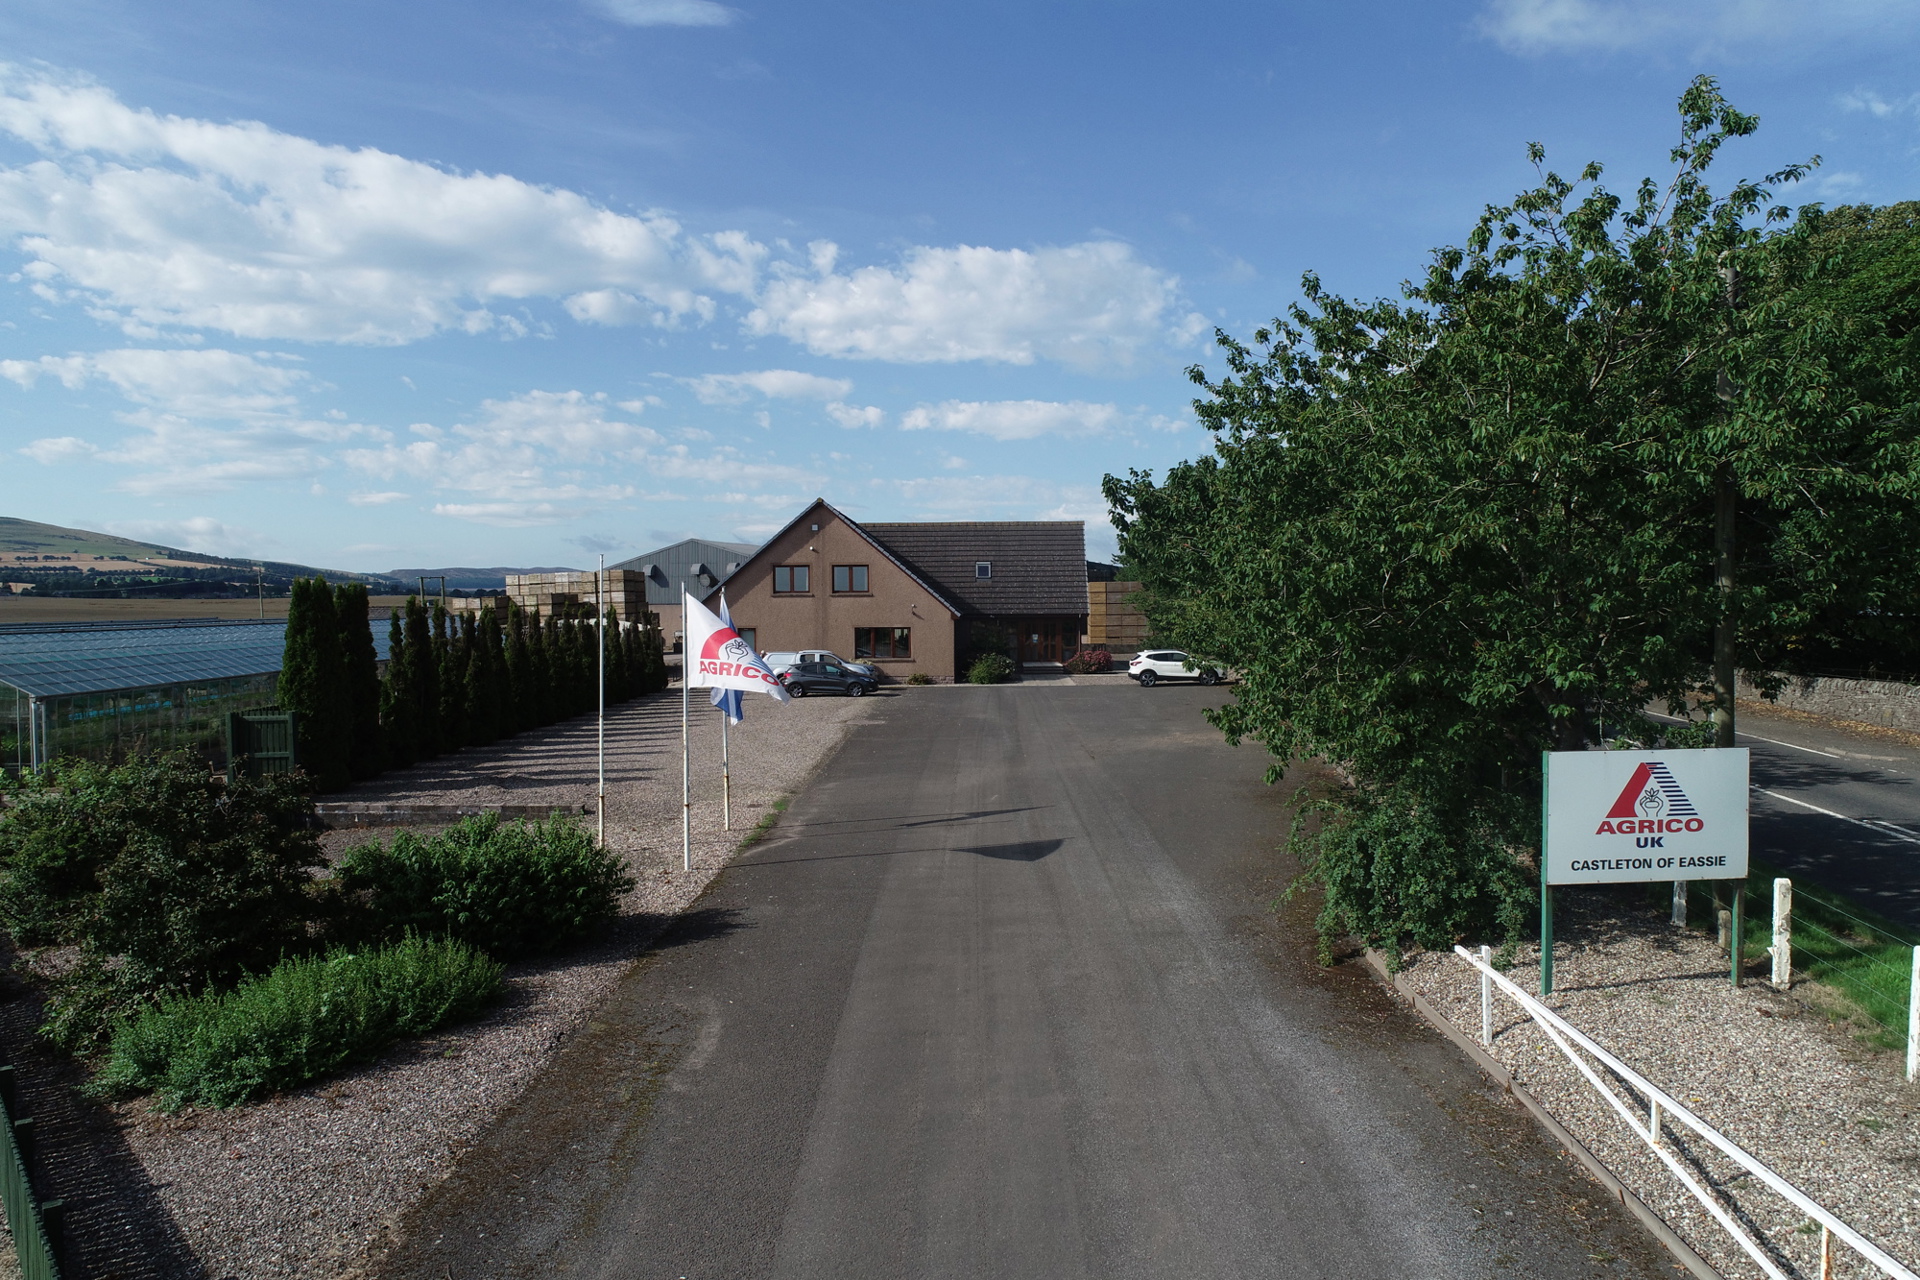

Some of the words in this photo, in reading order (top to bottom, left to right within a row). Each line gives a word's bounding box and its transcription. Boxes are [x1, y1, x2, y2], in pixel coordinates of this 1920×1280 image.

[699, 661, 780, 686] AGRICO
[1595, 818, 1704, 835] AGRICO
[1636, 836, 1664, 848] UK
[1571, 859, 1652, 871] CASTLETON
[1657, 857, 1675, 868] OF
[1679, 856, 1726, 867] EASSIE
